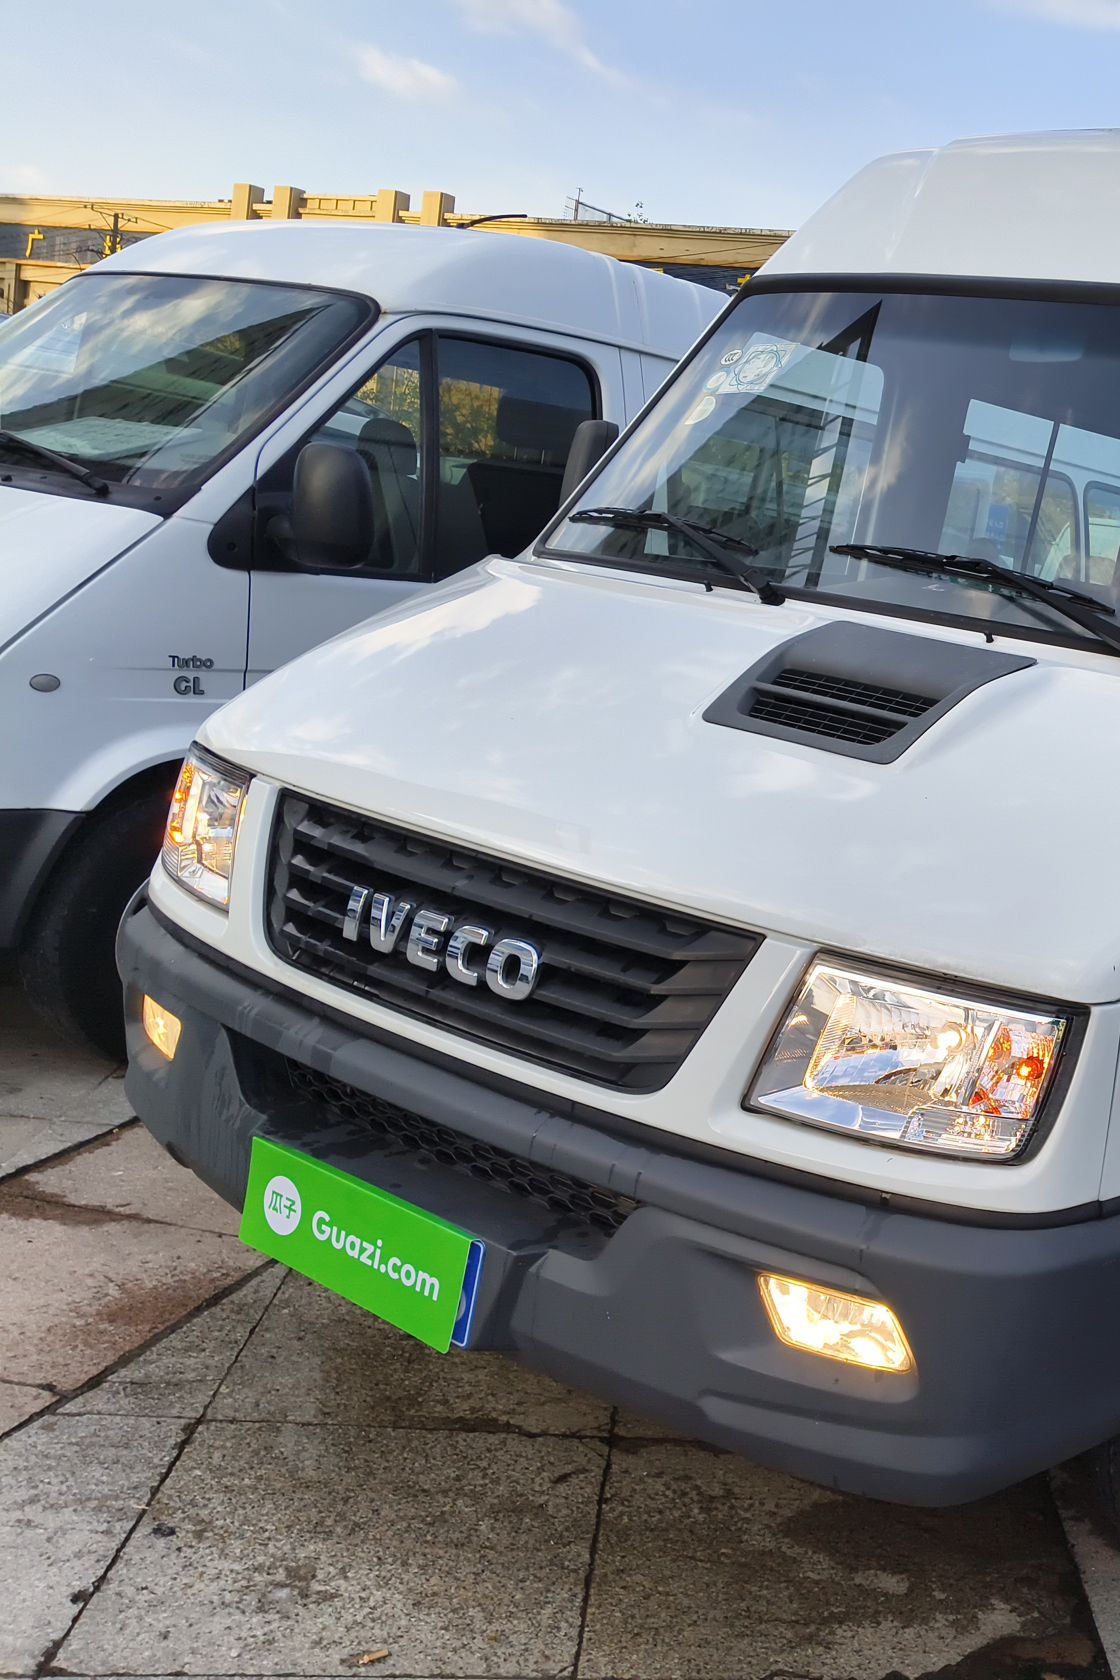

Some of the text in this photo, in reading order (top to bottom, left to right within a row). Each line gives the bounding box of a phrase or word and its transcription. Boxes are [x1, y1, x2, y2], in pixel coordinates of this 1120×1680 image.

[168, 655, 215, 669] Turbo
[173, 675, 205, 695] GL
[342, 885, 542, 1000] IVECO
[268, 1190, 298, 1219] 瓜子
[311, 1210, 440, 1302] Guazi.com
